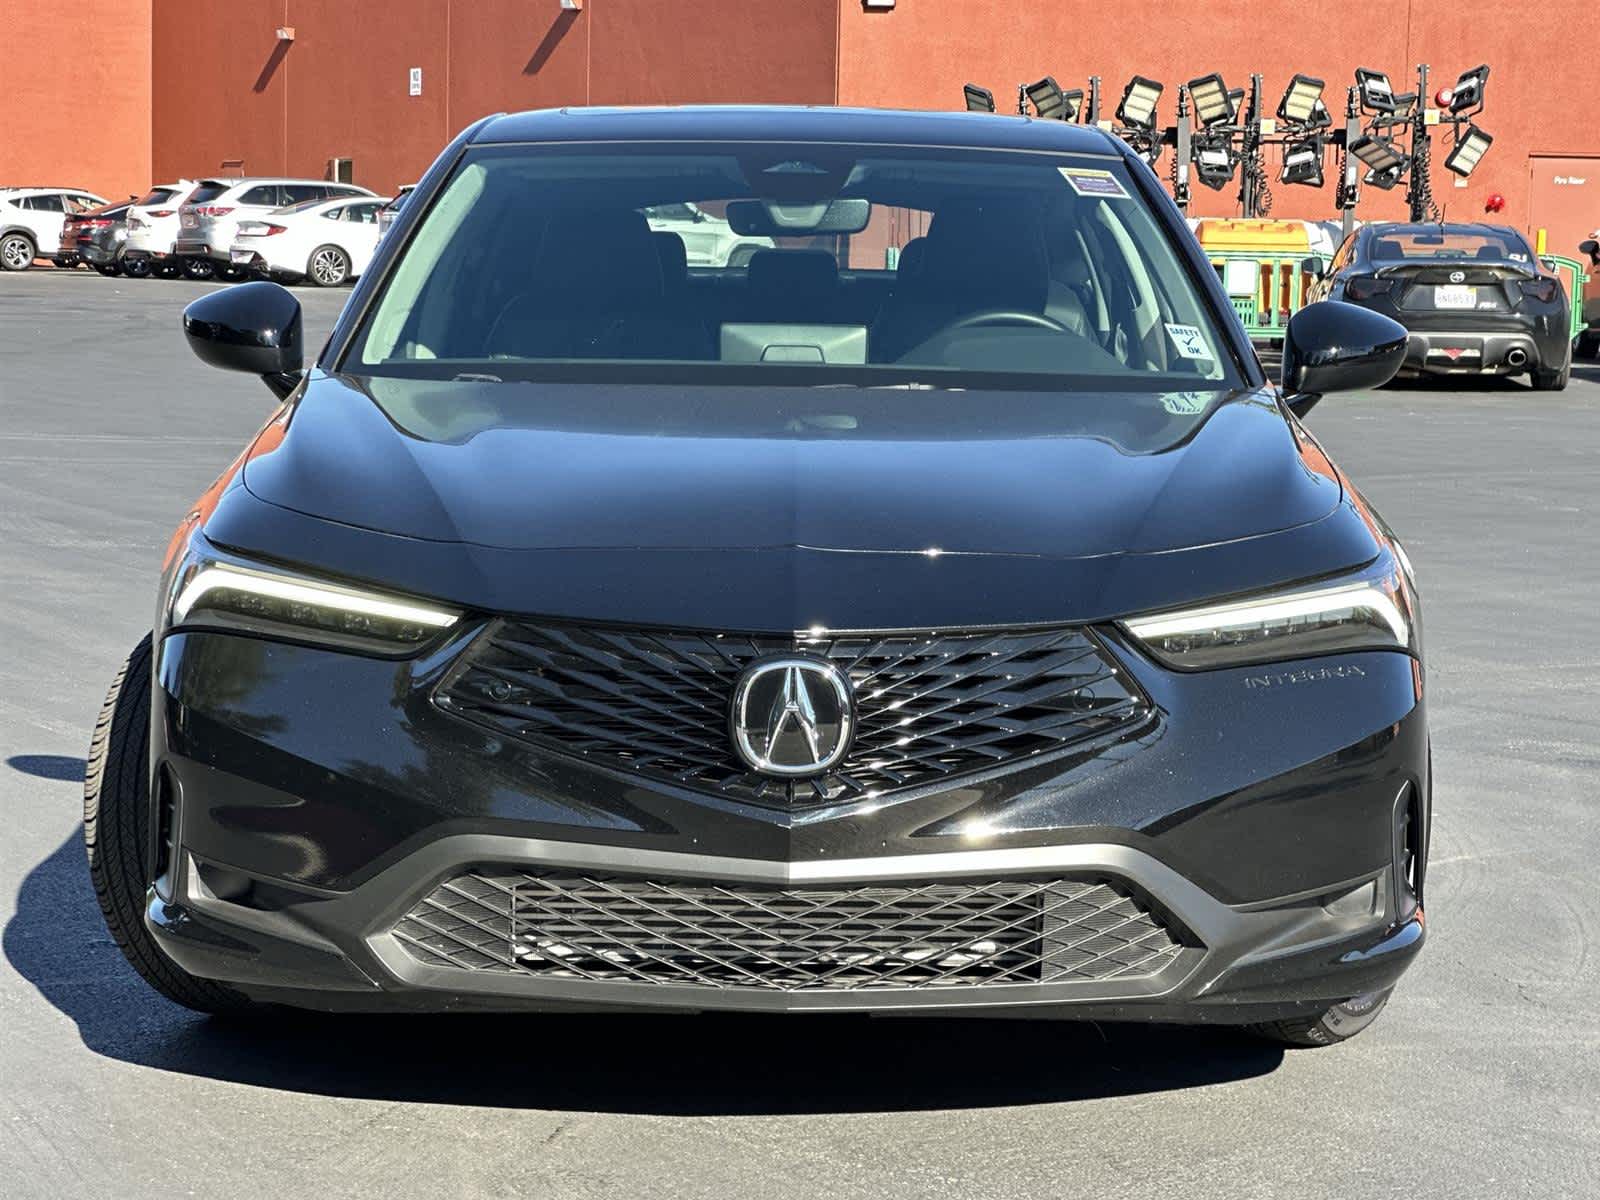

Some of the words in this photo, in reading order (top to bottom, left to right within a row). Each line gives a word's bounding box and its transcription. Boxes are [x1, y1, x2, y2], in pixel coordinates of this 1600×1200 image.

[1169, 327, 1199, 337] SAFETY
[1188, 347, 1203, 355] OK
[1244, 665, 1365, 688] INTEGRA
